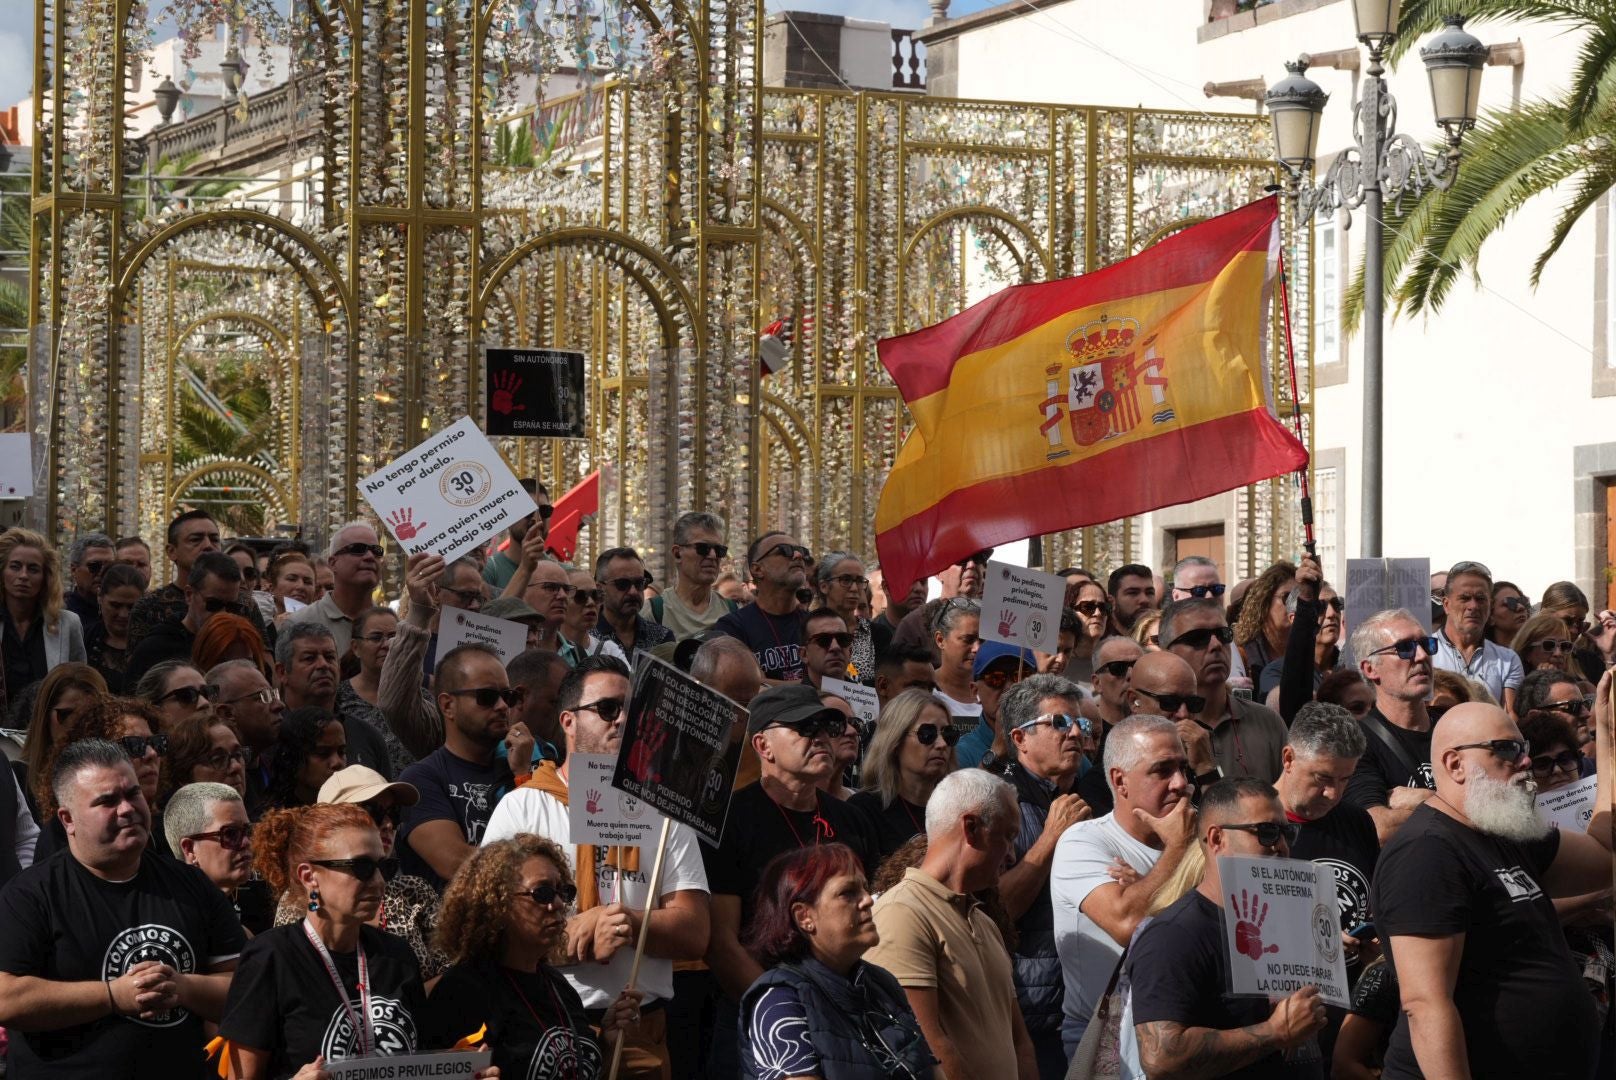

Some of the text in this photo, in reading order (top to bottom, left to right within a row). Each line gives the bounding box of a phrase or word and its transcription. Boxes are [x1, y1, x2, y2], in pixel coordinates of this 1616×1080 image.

[513, 354, 525, 363] SIN
[558, 386, 569, 398] 30
[513, 420, 540, 429] ESPAÑA
[542, 422, 551, 430] SE
[366, 480, 385, 494] No
[385, 459, 419, 484] tengo
[420, 429, 466, 467] permiso
[396, 474, 418, 495] por
[418, 454, 455, 485] duelo.
[450, 471, 474, 491] 30
[464, 486, 475, 496] N
[409, 488, 519, 555] Muera quien muera,
[438, 508, 509, 557] trabajo igual
[1011, 575, 1046, 589] No pedimos
[1002, 596, 1048, 611] pedimos justicia
[465, 619, 502, 635] No pedimos
[1032, 620, 1042, 633] 30
[651, 667, 739, 723] SIN COLORES POLÍTICOS
[663, 687, 676, 701] SIN
[661, 698, 674, 713] SIN
[863, 711, 873, 720] 30
[654, 707, 723, 751] SOLO AUTÓNOMOS
[588, 761, 616, 771] No teng
[708, 769, 722, 792] 30
[656, 784, 692, 809] PIDIENDO
[1545, 795, 1565, 805] tengo
[1566, 785, 1592, 798] derecho
[622, 778, 718, 836] QUE NOS DEJEN TRABAJAR
[1551, 796, 1588, 812] vacaciones
[587, 819, 608, 829] Muera
[609, 821, 629, 832] quien
[599, 831, 642, 842] trabajo igual
[1251, 866, 1317, 884] SI EL AUTÓNOMO
[1262, 883, 1313, 898] SE ENFERMA
[1319, 918, 1332, 938] 30
[1267, 963, 1281, 975] NO
[1283, 964, 1310, 977] PUEDE
[1257, 980, 1271, 991] LA
[1273, 979, 1302, 991] CUOTA
[345, 1066, 395, 1080] PEDIMOS
[398, 1061, 475, 1078] PRIVILEGIOS.
